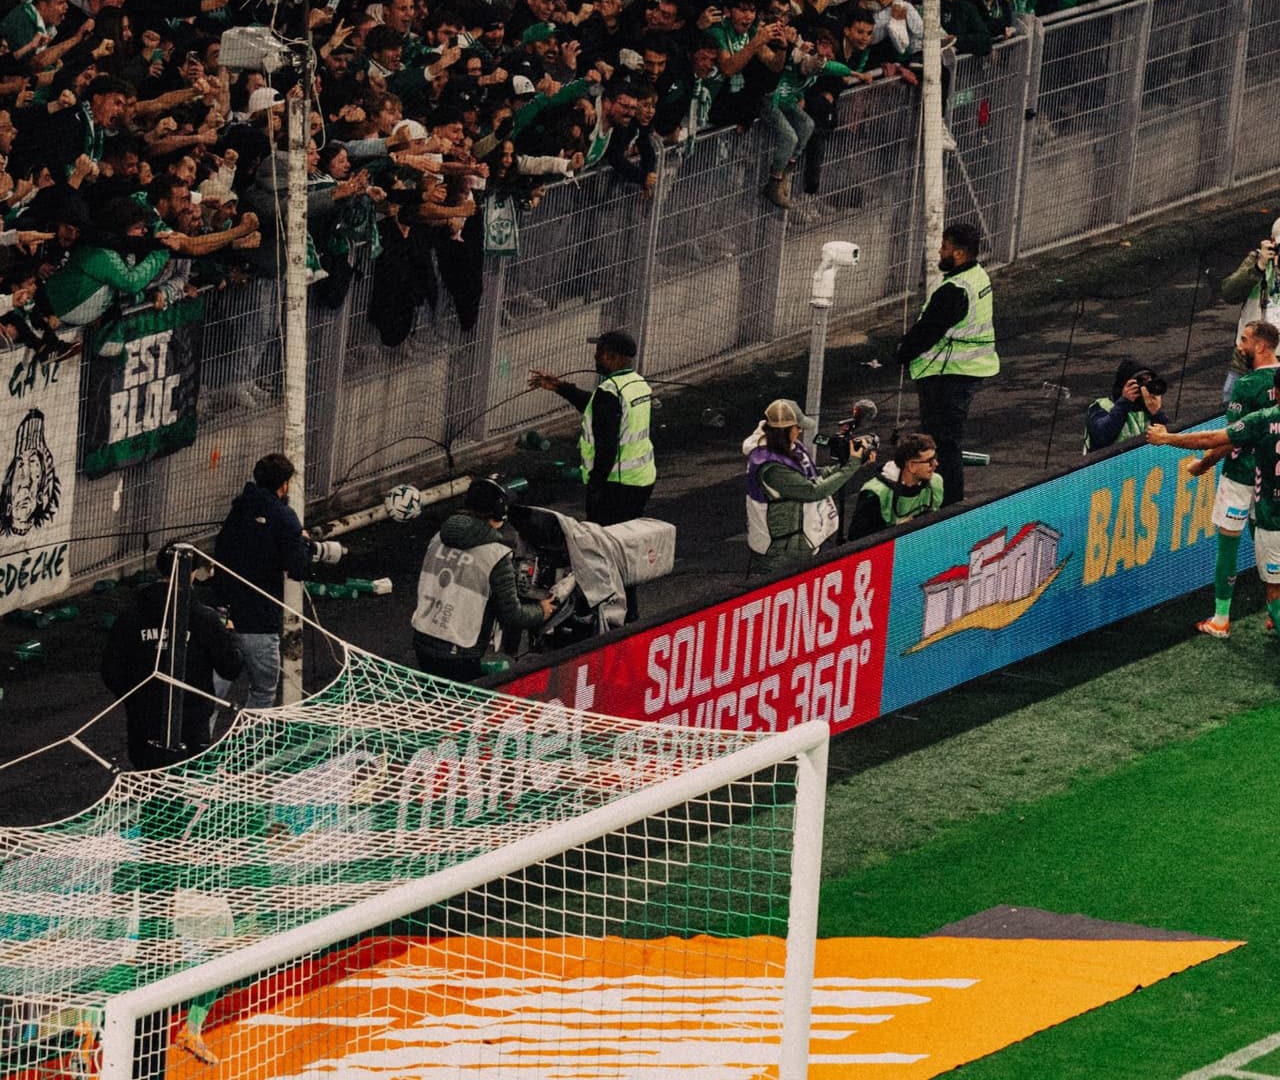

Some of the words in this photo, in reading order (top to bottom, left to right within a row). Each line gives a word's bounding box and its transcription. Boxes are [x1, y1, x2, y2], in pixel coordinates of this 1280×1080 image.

[123, 329, 173, 389] EST
[108, 373, 181, 445] BLOC
[434, 544, 474, 567] LFP
[1082, 467, 1163, 585] BAS
[643, 571, 841, 716] SOLUTIONS
[849, 559, 875, 638] &
